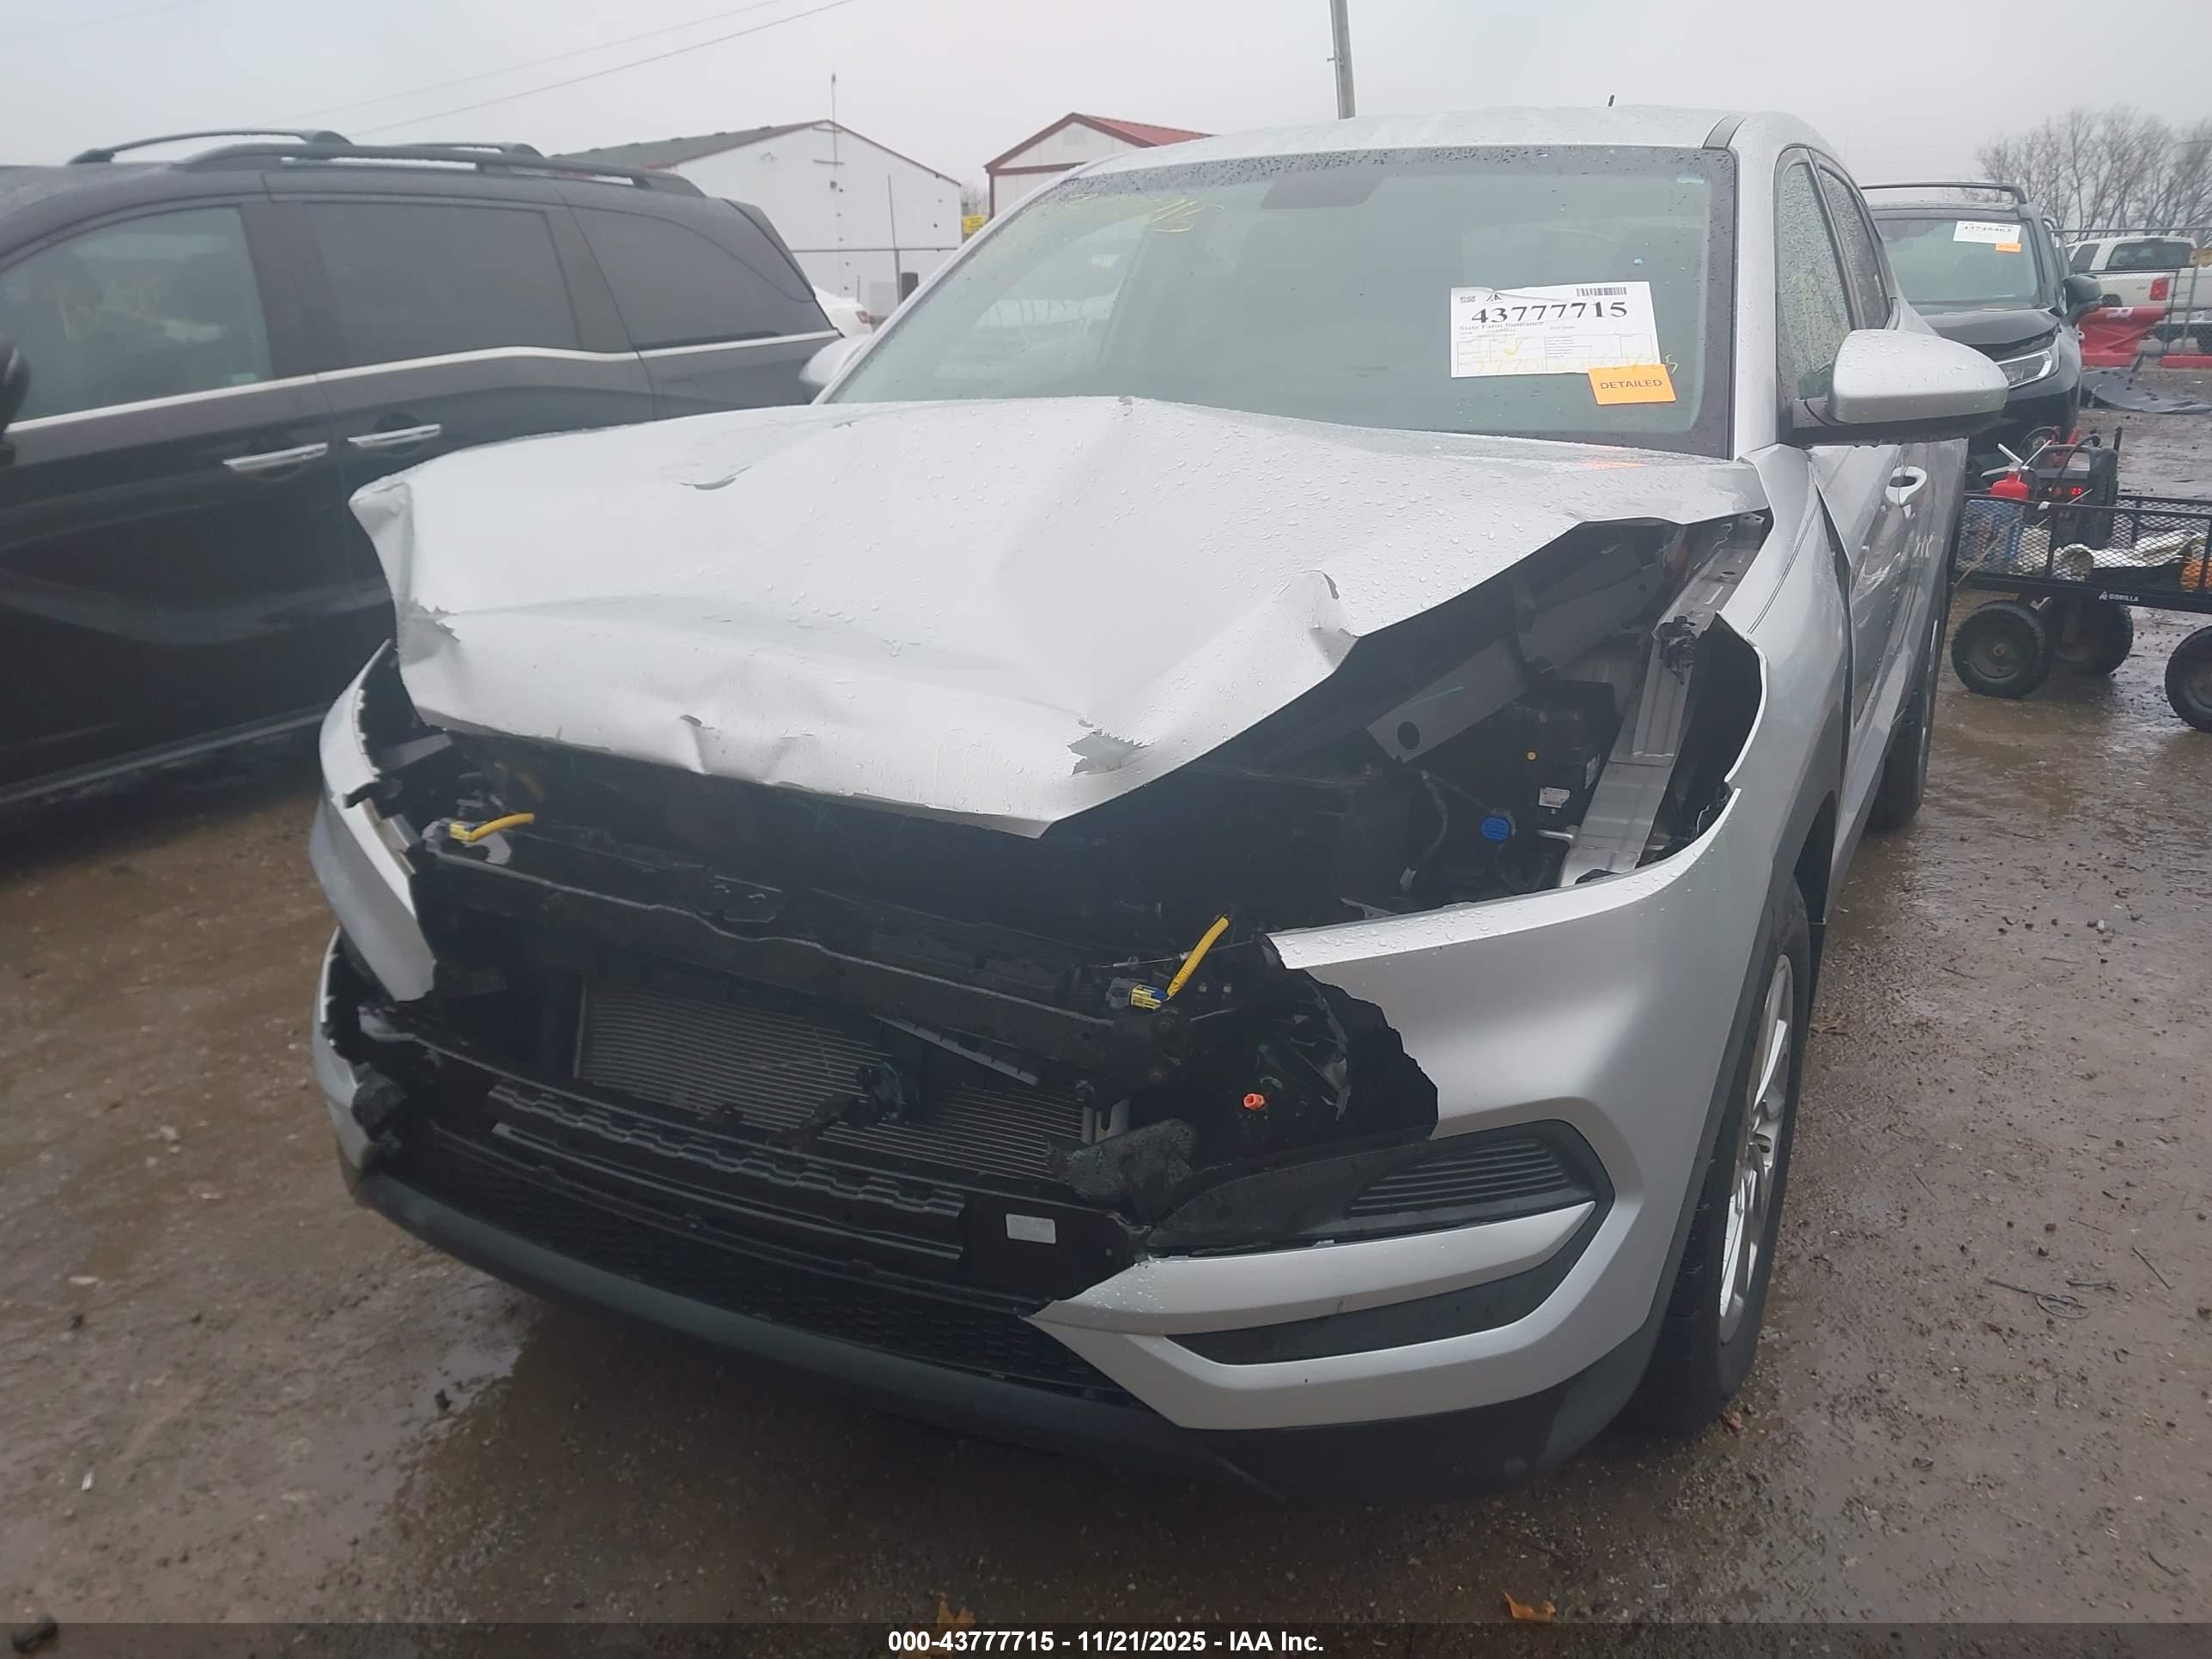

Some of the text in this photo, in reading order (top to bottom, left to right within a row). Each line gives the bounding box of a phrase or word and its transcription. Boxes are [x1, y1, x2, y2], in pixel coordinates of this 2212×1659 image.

[1471, 301, 1628, 323] 43777715
[1600, 379, 1663, 390] DETAILED
[2108, 593, 2139, 603] GORILLA
